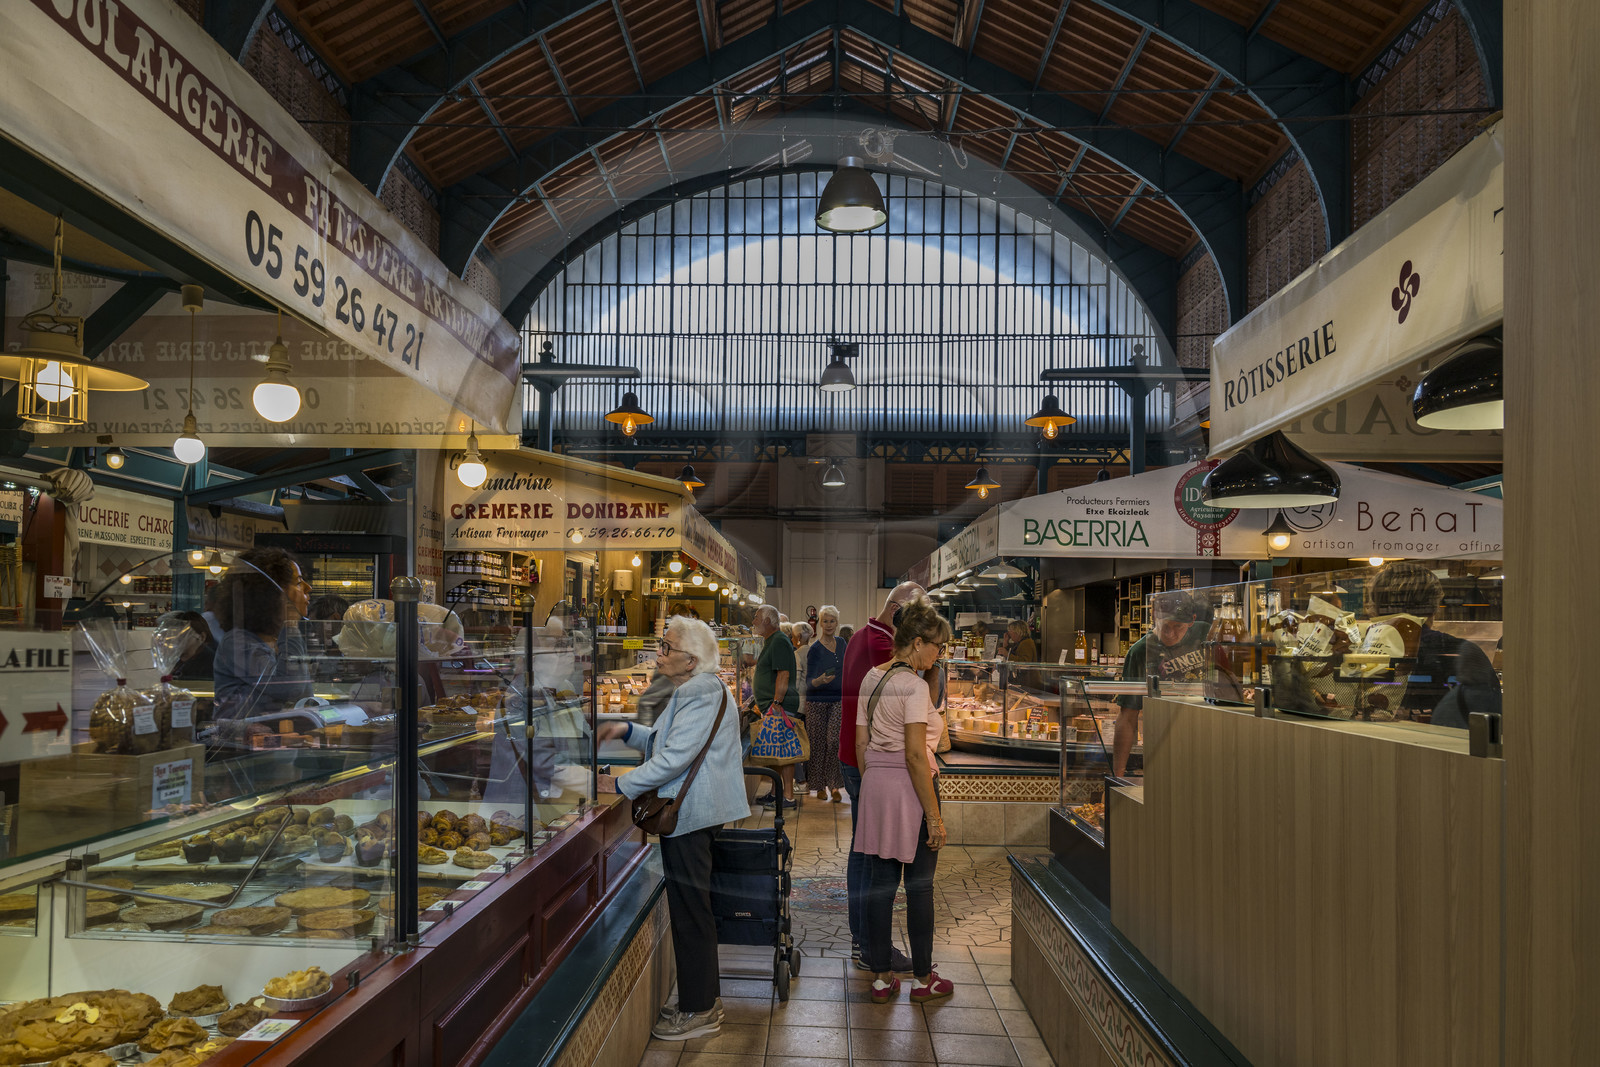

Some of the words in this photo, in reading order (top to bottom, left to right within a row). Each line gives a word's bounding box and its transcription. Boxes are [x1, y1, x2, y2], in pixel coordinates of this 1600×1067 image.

[245, 209, 283, 280] 05
[294, 245, 326, 307] 59
[335, 276, 365, 333] 26
[372, 308, 399, 355] 47
[402, 323, 424, 371] 21
[1223, 320, 1337, 412] RÔTISSERIE
[471, 472, 553, 491] andrine
[1066, 495, 1113, 506] Producteurs
[1115, 496, 1150, 506] Fermiers
[450, 502, 553, 520] CREMERIE
[566, 502, 670, 520] DONIBANE
[1085, 508, 1105, 516] Etxe
[1107, 508, 1150, 516] Ekoizleak
[130, 535, 156, 547] ESPELETTE
[450, 527, 493, 539] Artisan
[496, 527, 549, 540] Fromager
[1023, 518, 1150, 548] BASERRIA
[1303, 539, 1354, 549] artisan
[1371, 539, 1440, 552] fromager
[1458, 540, 1502, 551] affine
[25, 648, 70, 668] FILE
